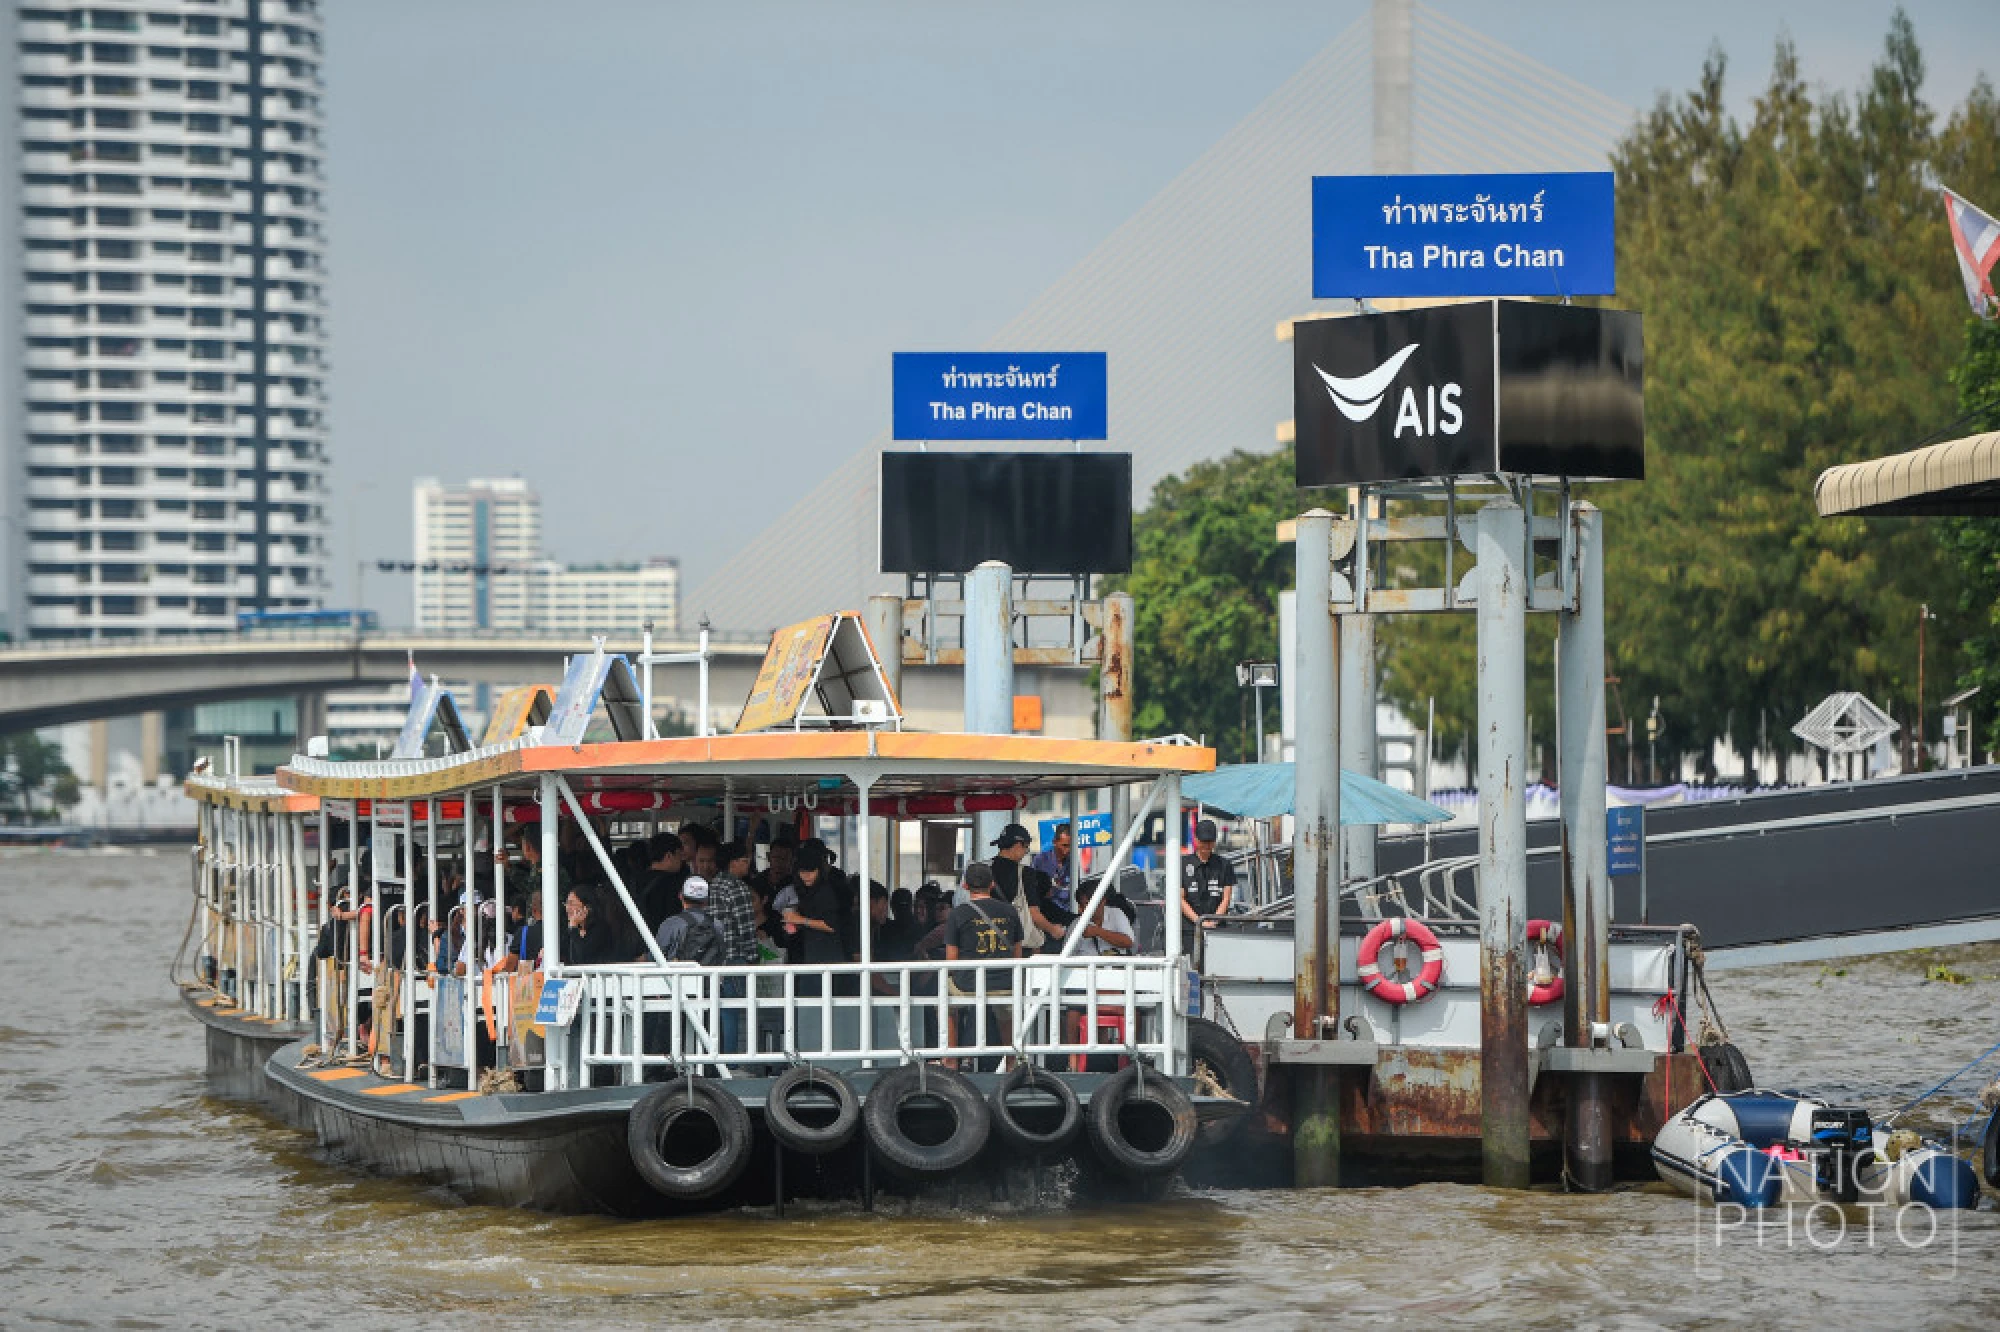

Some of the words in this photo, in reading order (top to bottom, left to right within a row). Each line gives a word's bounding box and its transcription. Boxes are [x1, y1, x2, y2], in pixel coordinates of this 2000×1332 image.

[1382, 190, 1545, 224] ท่าพระจันทร์
[1364, 245, 1414, 268] Tha
[1423, 245, 1485, 268] Phra
[1494, 243, 1564, 268] Chan
[942, 364, 1061, 389] ท่าพระจันทร์
[929, 402, 967, 420] Tha
[972, 402, 1016, 420] Phra
[1022, 402, 1073, 420] Chan
[1394, 382, 1463, 438] AIS
